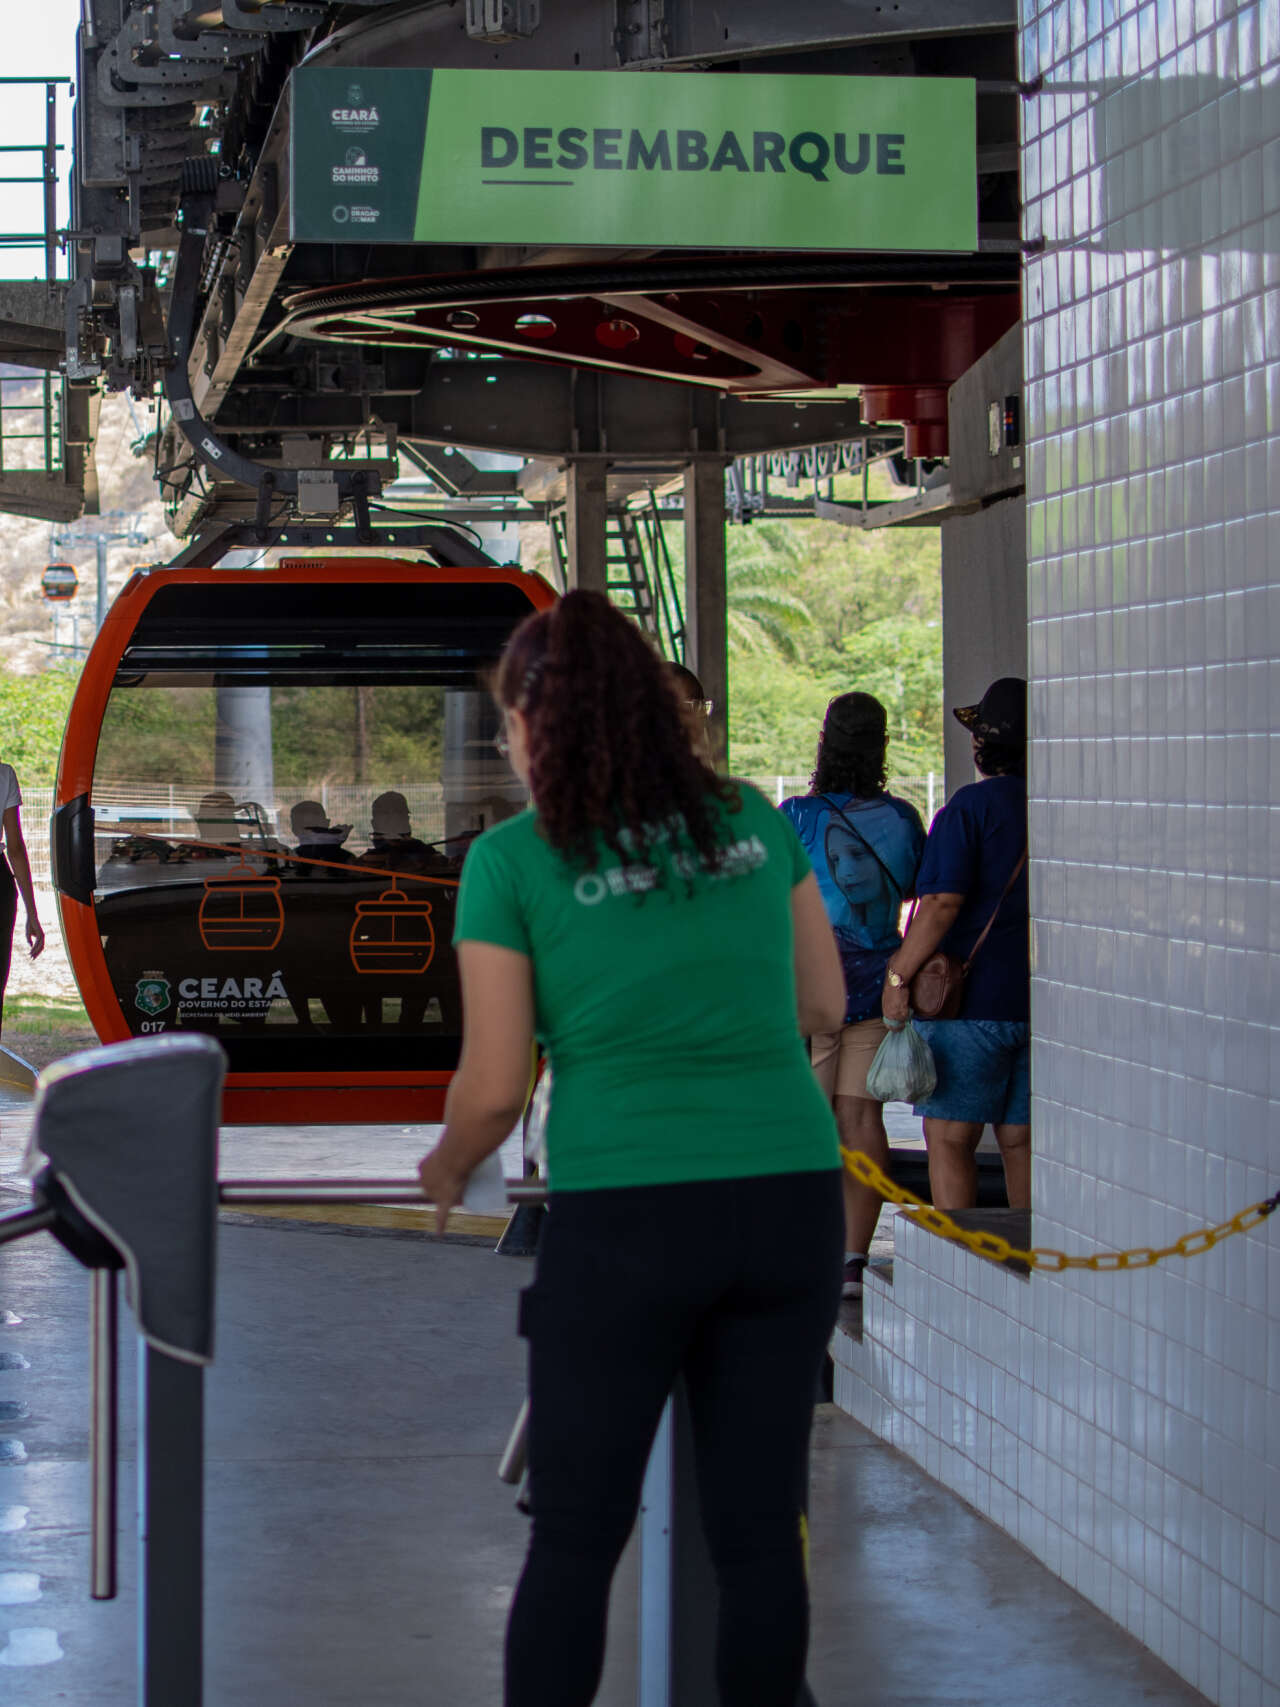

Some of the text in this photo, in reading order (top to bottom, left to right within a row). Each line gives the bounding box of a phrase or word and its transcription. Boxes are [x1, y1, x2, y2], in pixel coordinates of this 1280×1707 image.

[331, 107, 379, 120] CEARÁ
[480, 126, 906, 182] DESEMBARQUE
[178, 970, 288, 999] CEARÁ
[178, 1000, 228, 1008] GOVERNO
[230, 1000, 246, 1008] DO
[140, 1021, 166, 1033] 017
